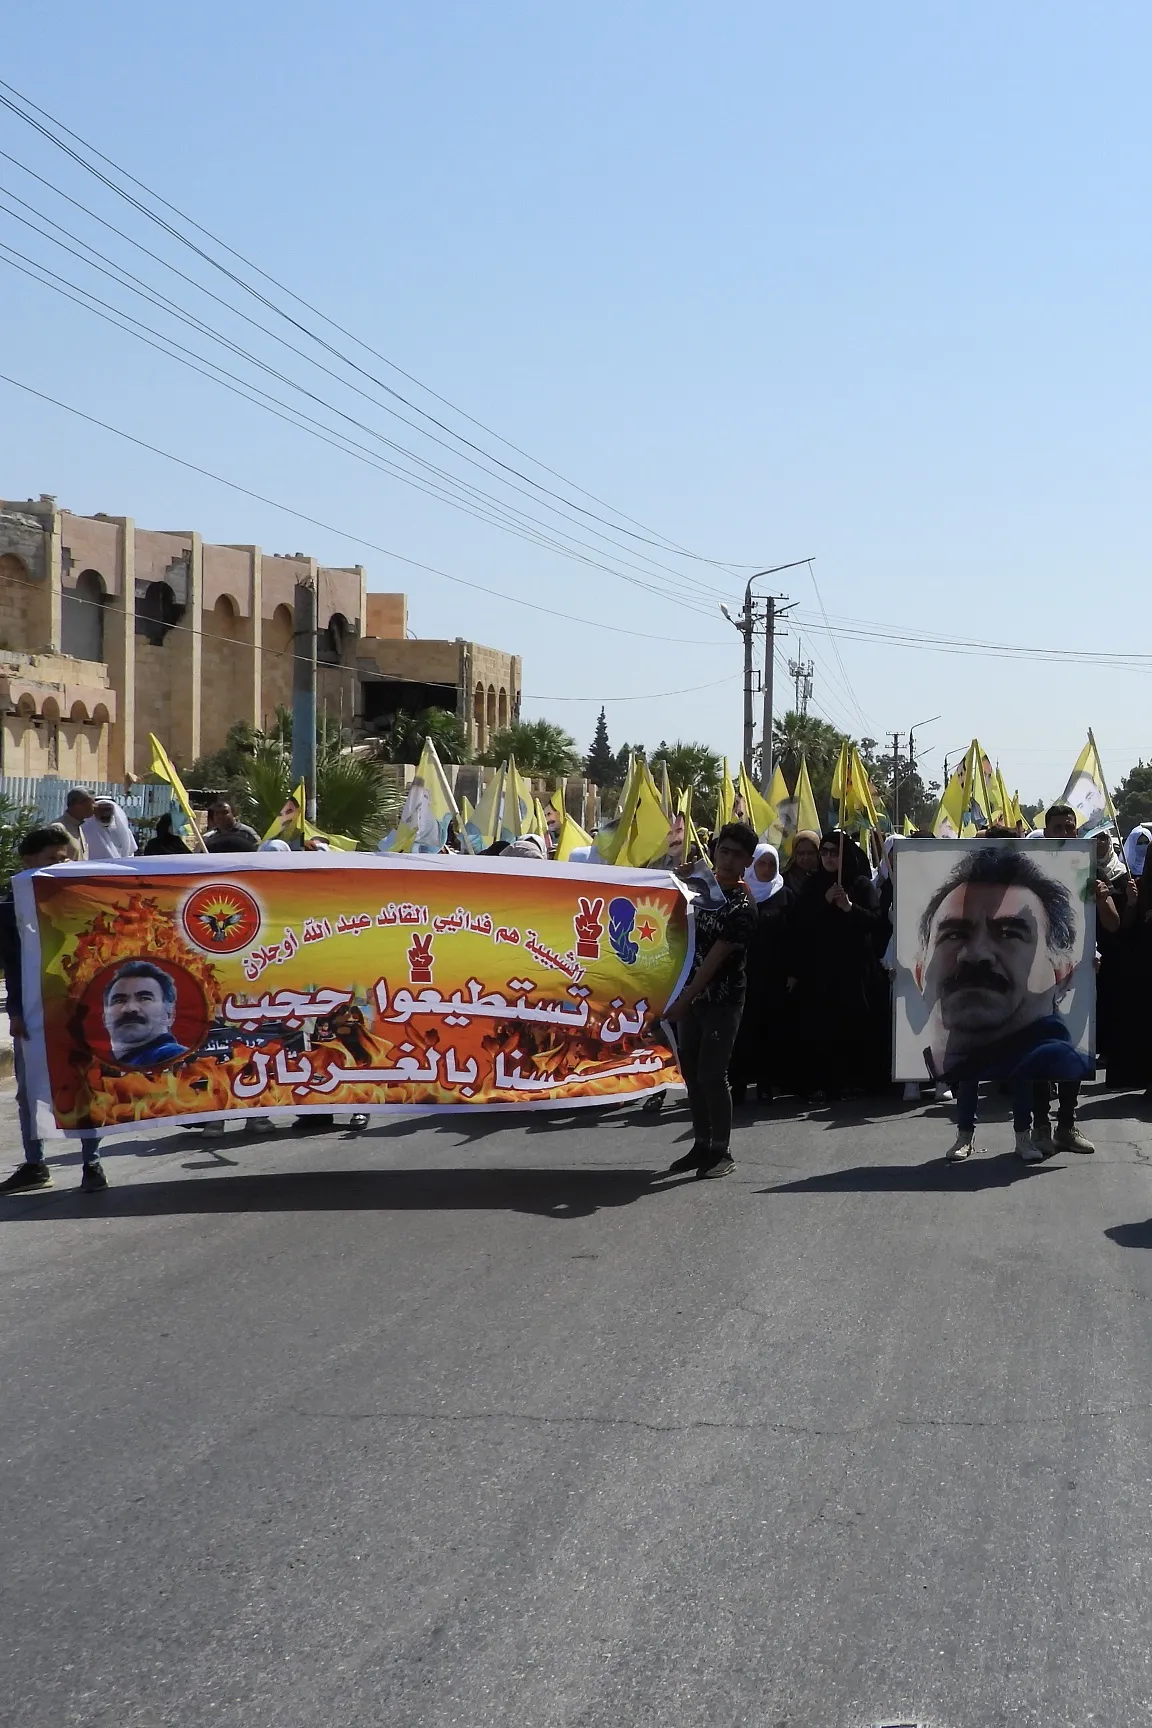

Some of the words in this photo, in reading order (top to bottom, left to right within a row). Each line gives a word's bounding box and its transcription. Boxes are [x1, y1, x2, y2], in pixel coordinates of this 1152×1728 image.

[336, 914, 372, 936] عبد
[377, 903, 428, 926] القائد
[495, 927, 521, 945] هم
[243, 927, 299, 980] أوجلان
[524, 929, 585, 982] الشبيبة
[223, 987, 354, 1032] حجب
[374, 977, 590, 1028] تستطيعوا
[599, 998, 649, 1043] لن
[232, 1042, 479, 1098] بالغربال
[495, 1048, 664, 1090] شمسنا
